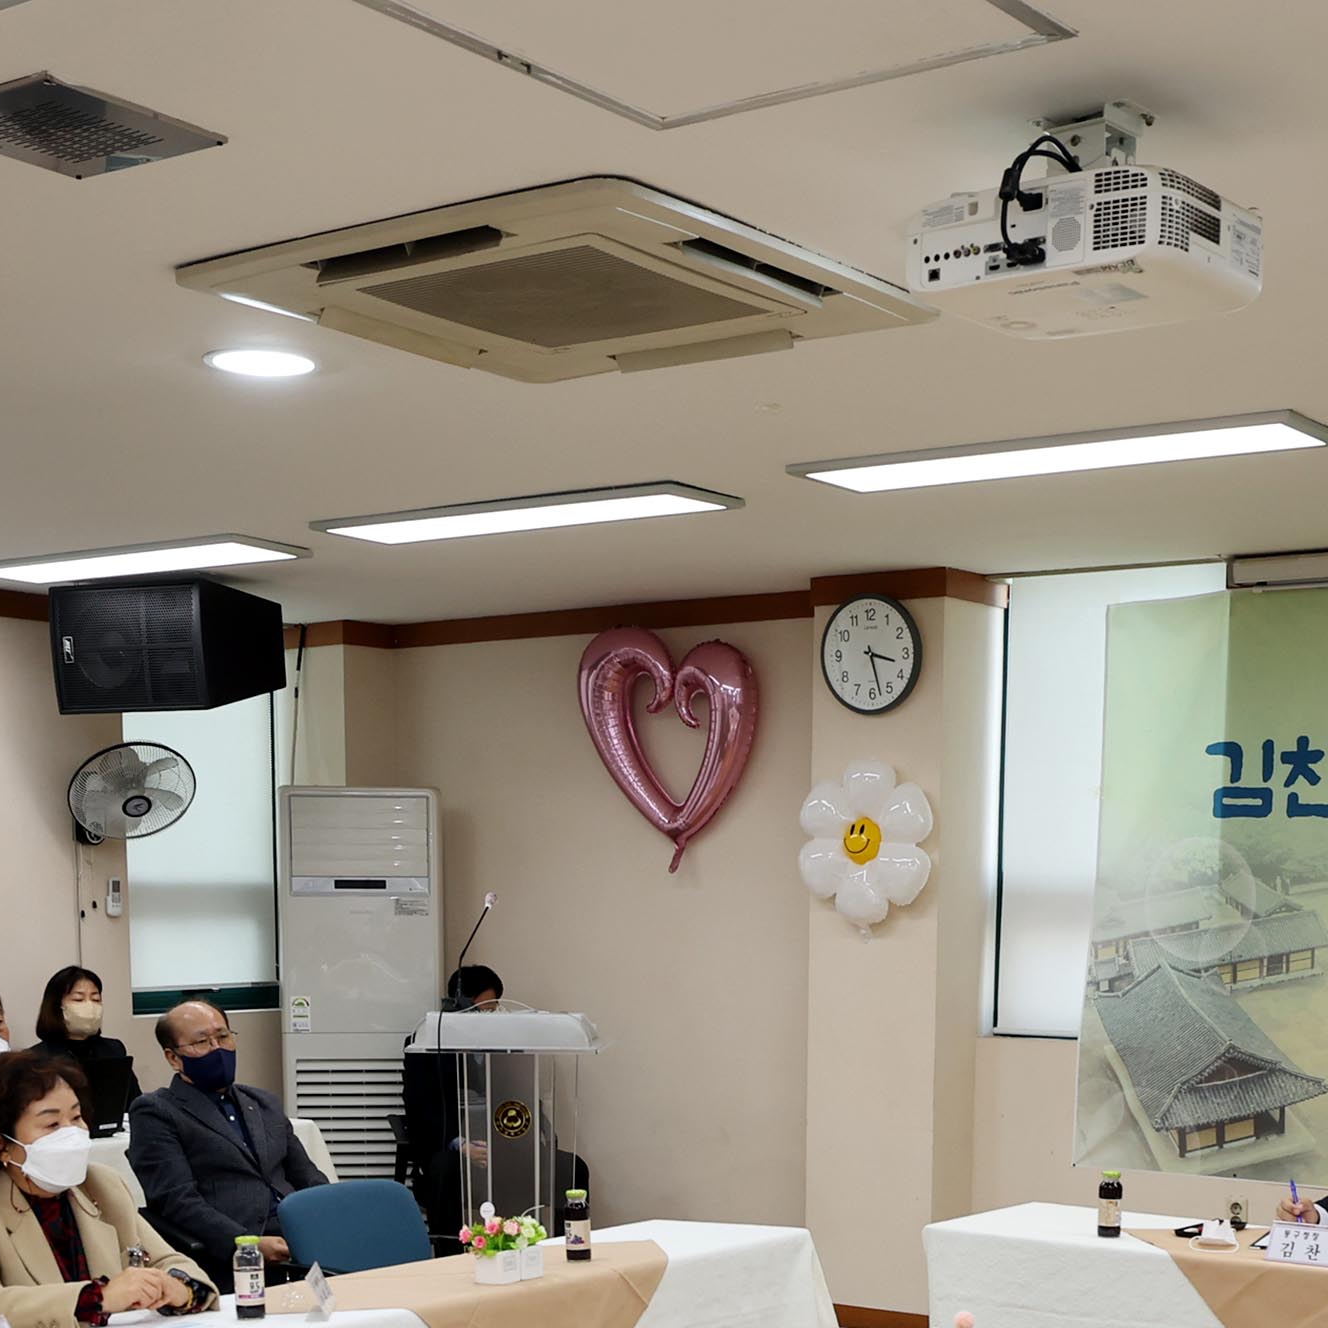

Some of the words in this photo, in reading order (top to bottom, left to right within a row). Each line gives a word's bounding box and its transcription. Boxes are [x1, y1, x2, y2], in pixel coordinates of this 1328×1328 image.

[849, 614, 859, 626] 11
[864, 608, 876, 621] 12
[884, 614, 890, 625] 1
[838, 629, 850, 642] 10
[896, 627, 904, 640] 2
[835, 650, 842, 662] 9
[902, 647, 910, 660] 3
[841, 671, 849, 683] 8
[897, 669, 904, 680] 4
[854, 684, 861, 696] 7
[868, 688, 876, 700] 6
[886, 682, 893, 694] 5
